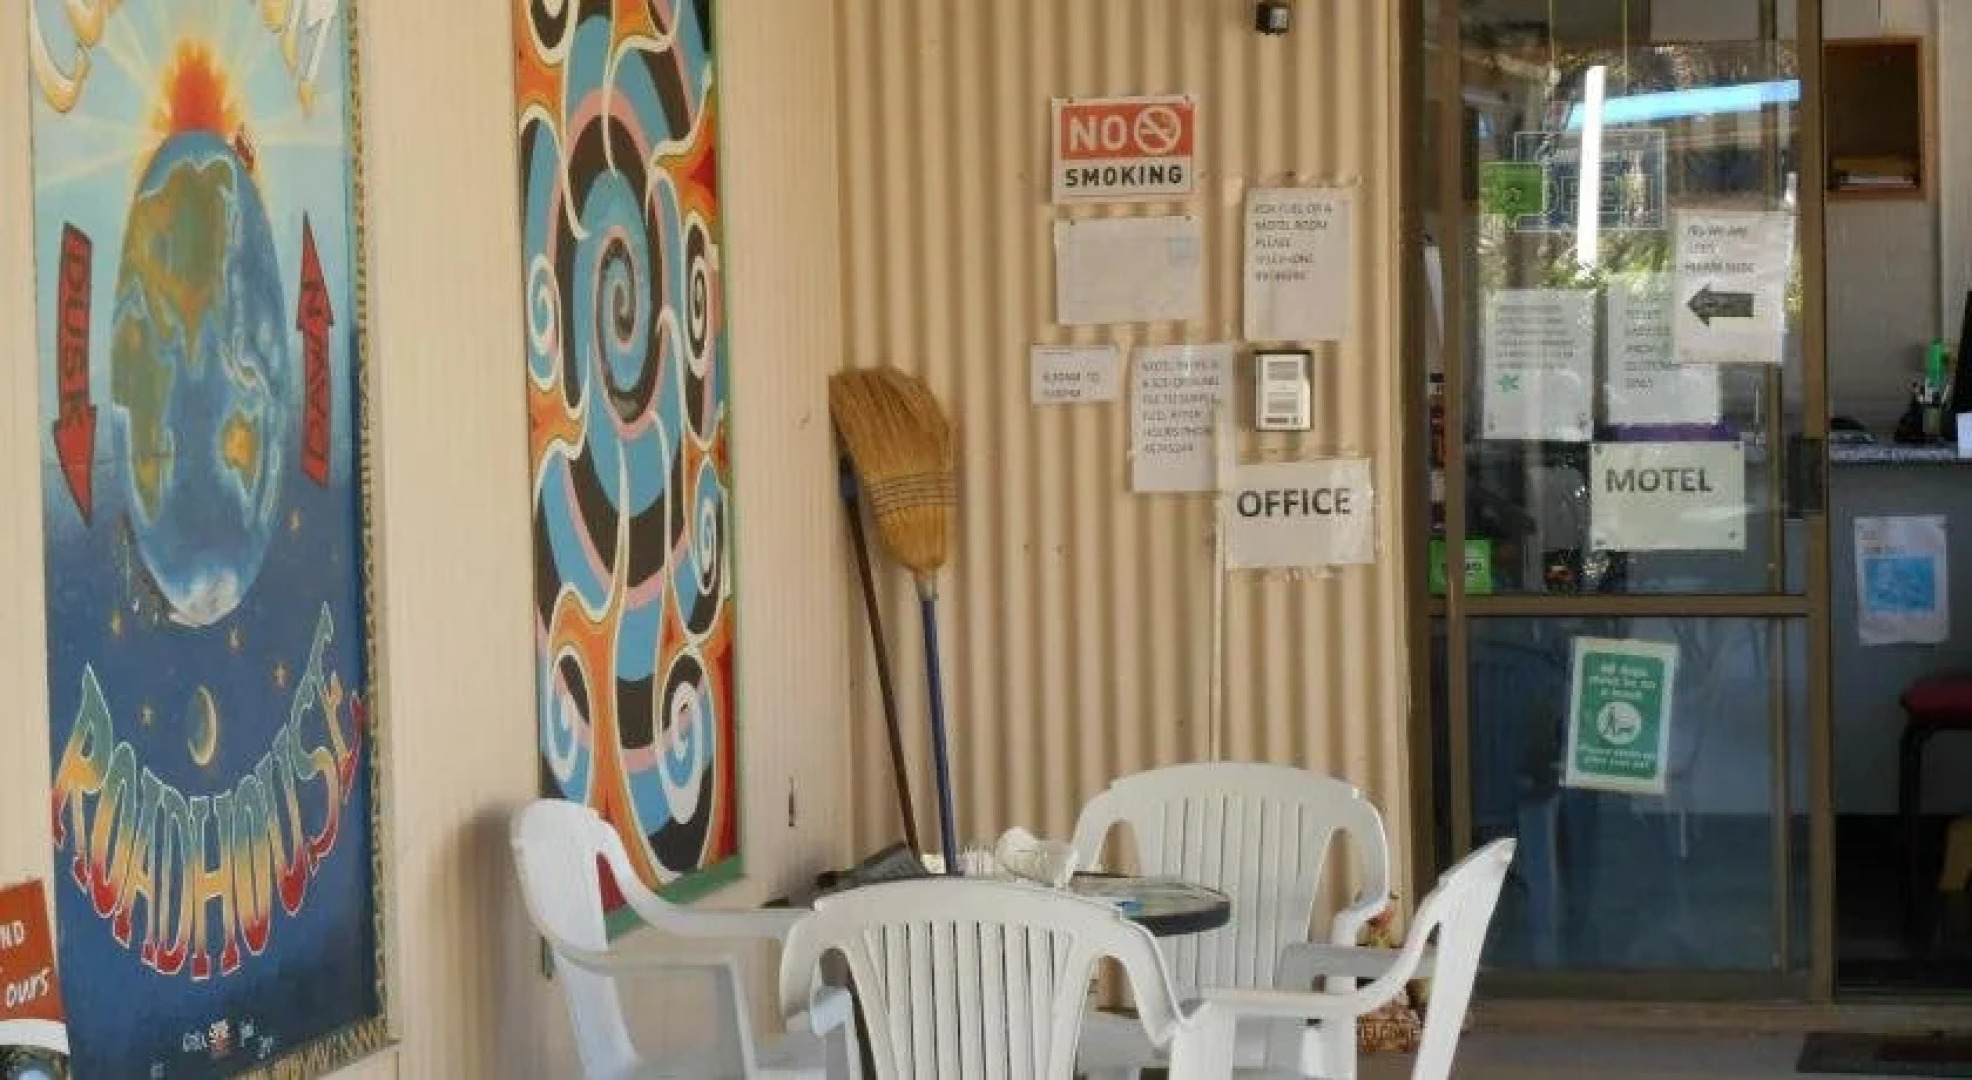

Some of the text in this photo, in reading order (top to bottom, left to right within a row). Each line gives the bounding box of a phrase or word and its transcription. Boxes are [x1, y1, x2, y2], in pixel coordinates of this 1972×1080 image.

[1069, 114, 1127, 152] NO
[1065, 165, 1182, 187] SMOKING
[1605, 468, 1713, 493] MOTEL
[1237, 488, 1351, 517] OFFICE
[51, 600, 362, 981] ROADHOUSE
